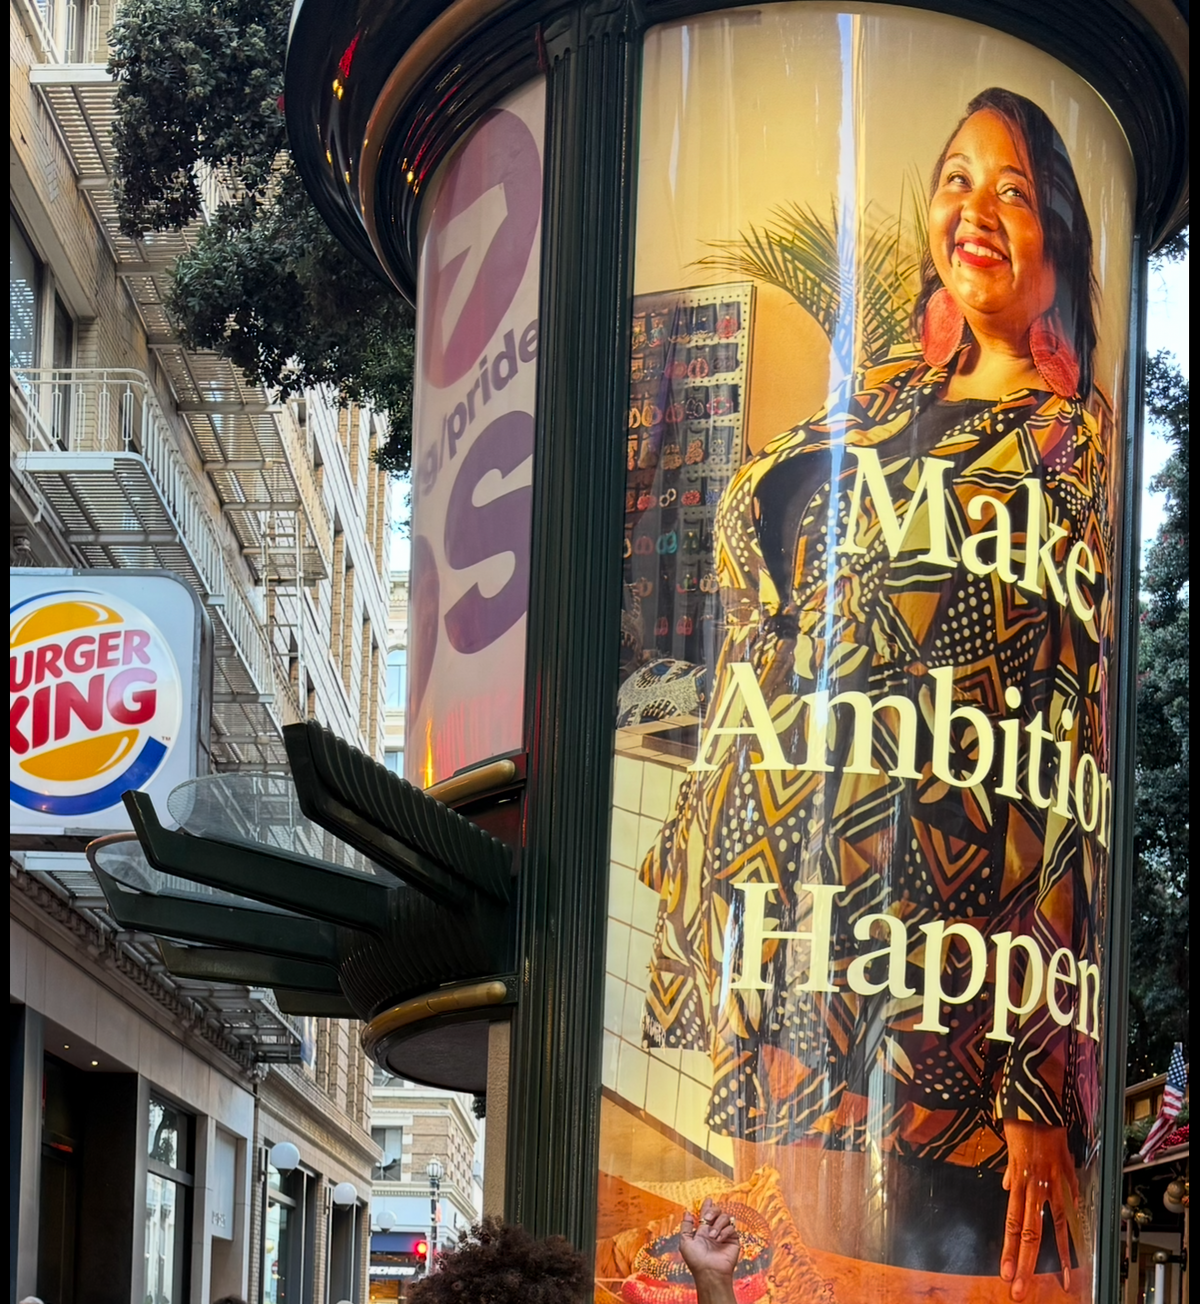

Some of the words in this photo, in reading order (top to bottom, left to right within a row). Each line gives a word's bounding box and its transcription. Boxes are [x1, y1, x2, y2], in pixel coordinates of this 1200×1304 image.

[836, 445, 1098, 622] Make
[10, 629, 151, 693] URGER
[688, 661, 1111, 854] Ambition
[731, 882, 1100, 1042] Happen
